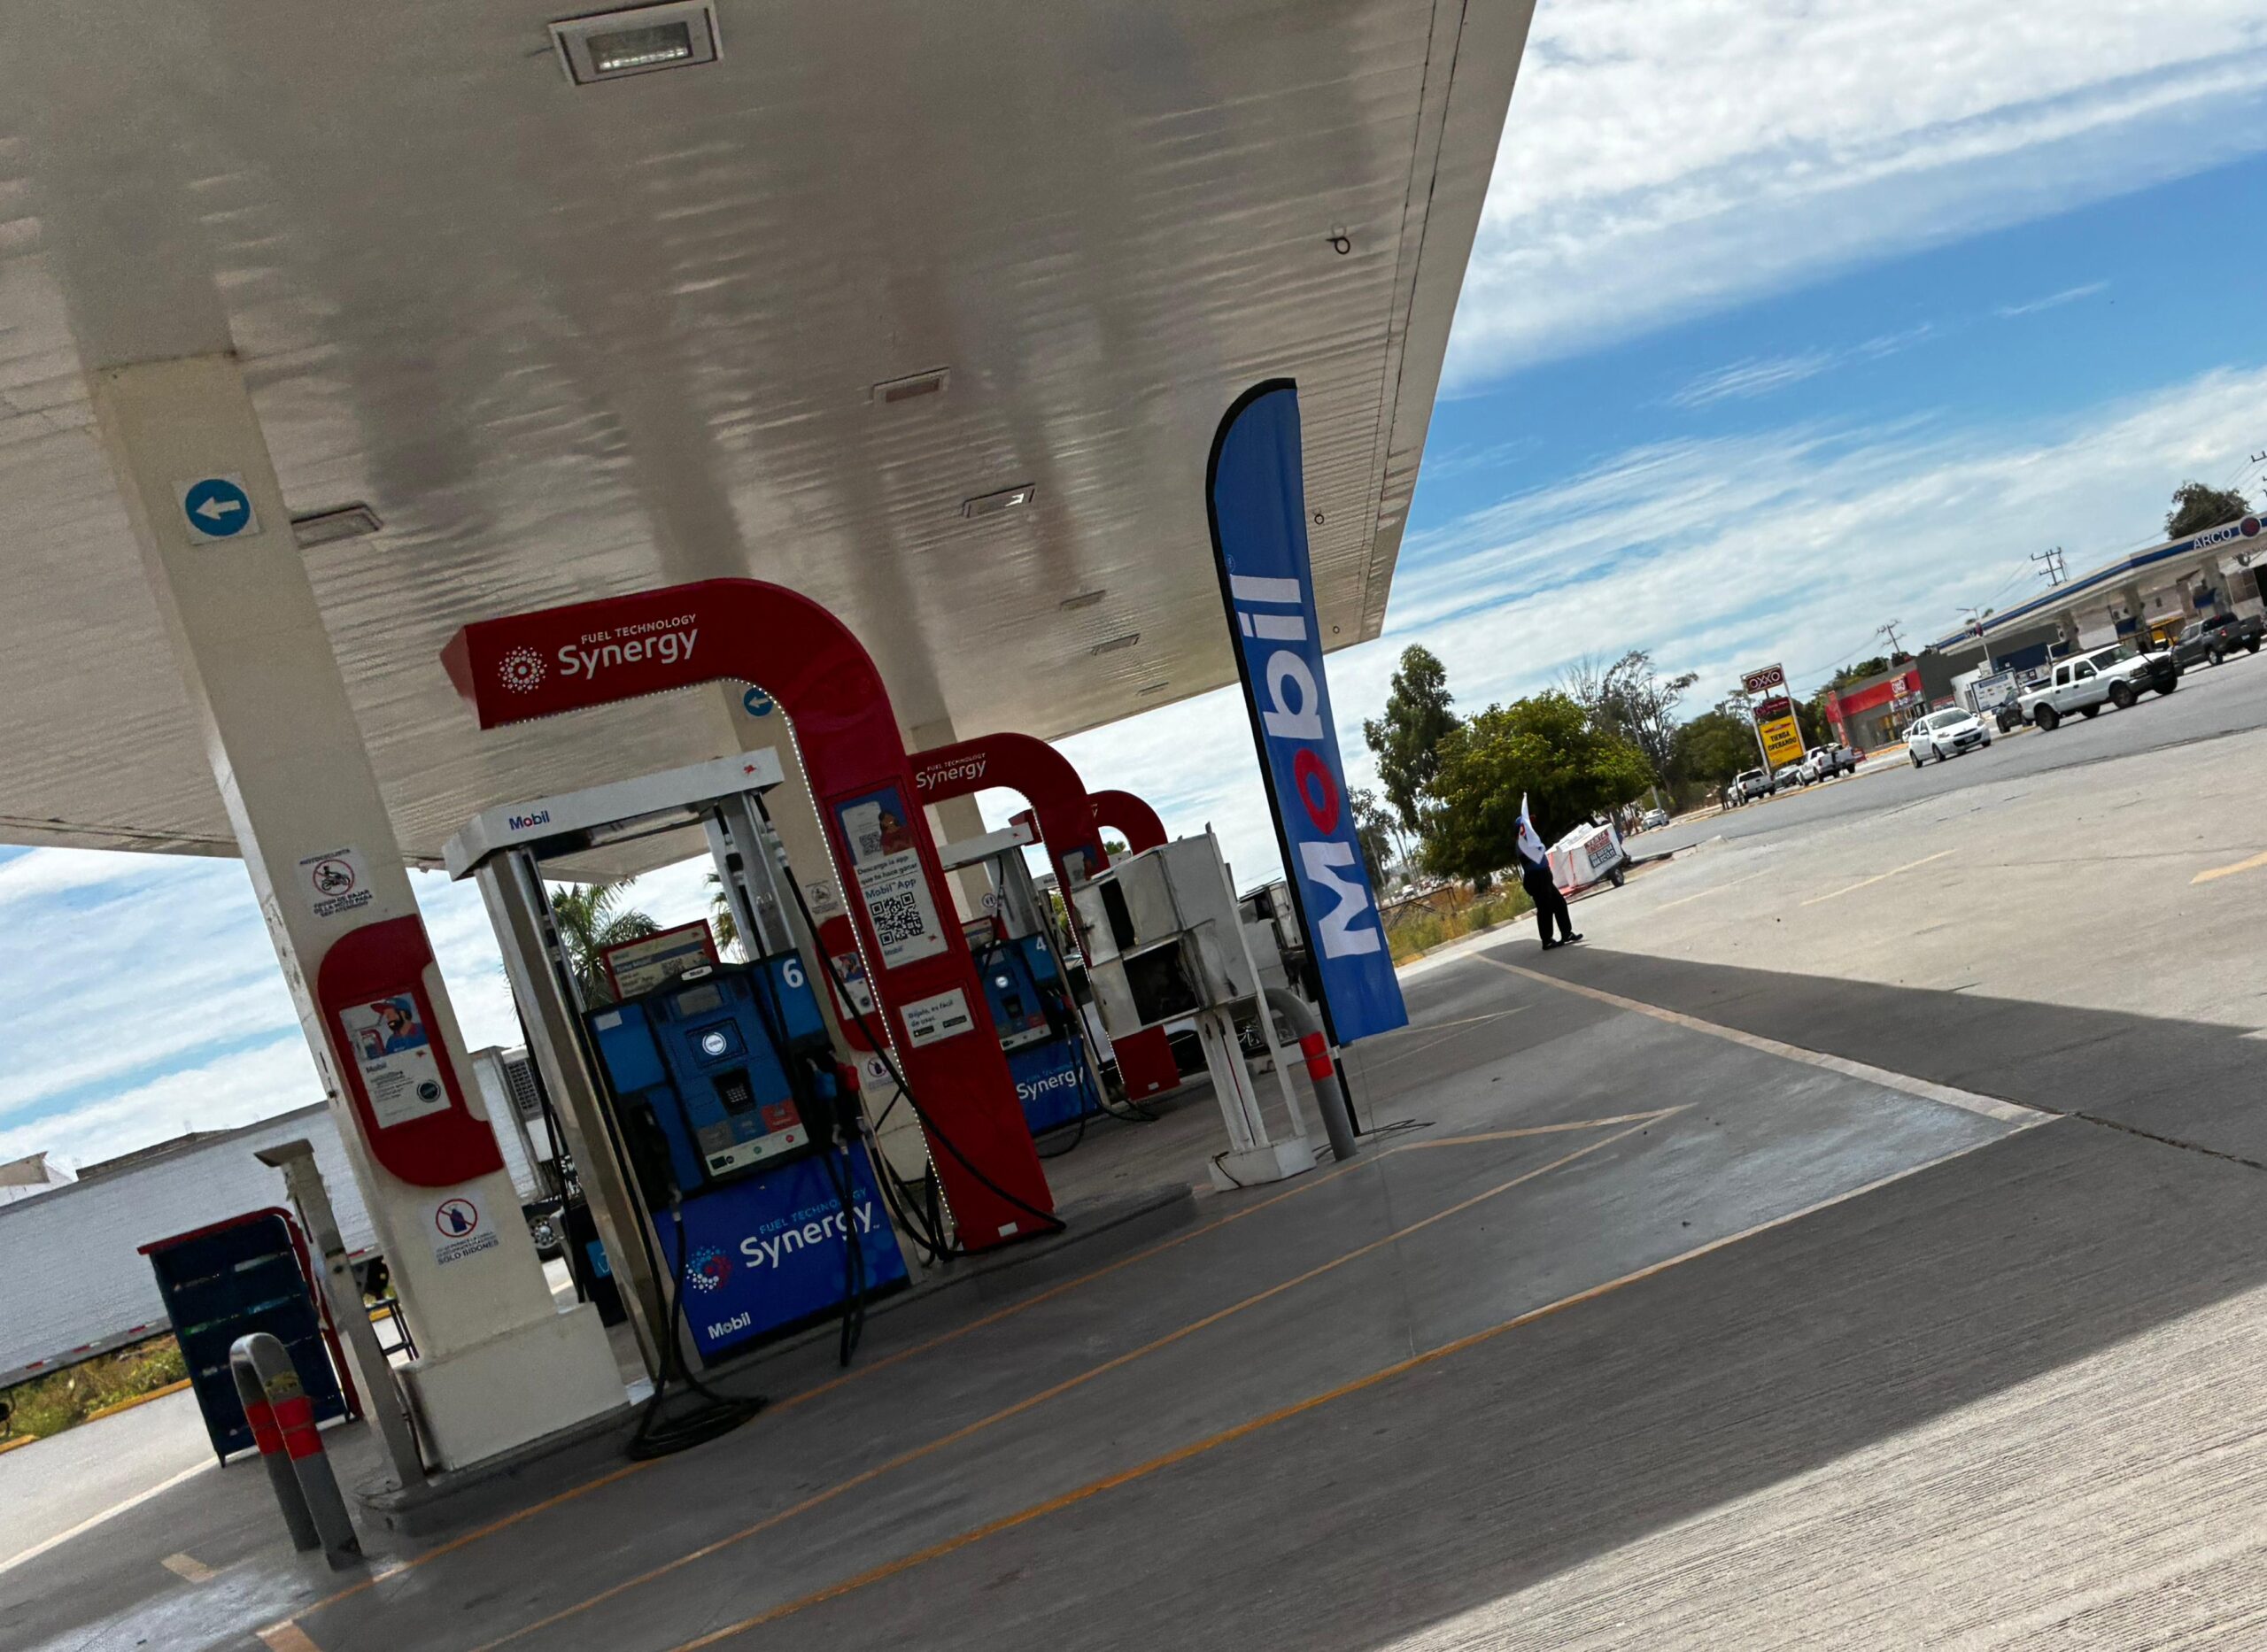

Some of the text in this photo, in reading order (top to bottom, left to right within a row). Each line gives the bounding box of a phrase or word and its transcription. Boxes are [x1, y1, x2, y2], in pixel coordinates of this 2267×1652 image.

[2193, 529, 2232, 550] ARCO
[581, 614, 696, 645] FUEL TECHNOLOGY
[558, 629, 698, 680] Synergy
[1749, 671, 1780, 688] OXXO
[1768, 737, 1797, 751] OPERANDO
[944, 753, 986, 768] TECHNOLOGY
[1230, 574, 1381, 959] Mobil
[916, 760, 986, 790] Synergy
[509, 810, 550, 830] Mobil
[857, 861, 887, 875] Descarga
[895, 854, 909, 864] app
[899, 863, 917, 873] ganar
[896, 876, 917, 890] App
[1036, 936, 1047, 952] 4
[783, 959, 803, 988] 6
[760, 1218, 788, 1234] FUEL
[437, 1252, 461, 1264] SOLO
[462, 1239, 499, 1255] BIDONES
[708, 1312, 751, 1339] Mobil
